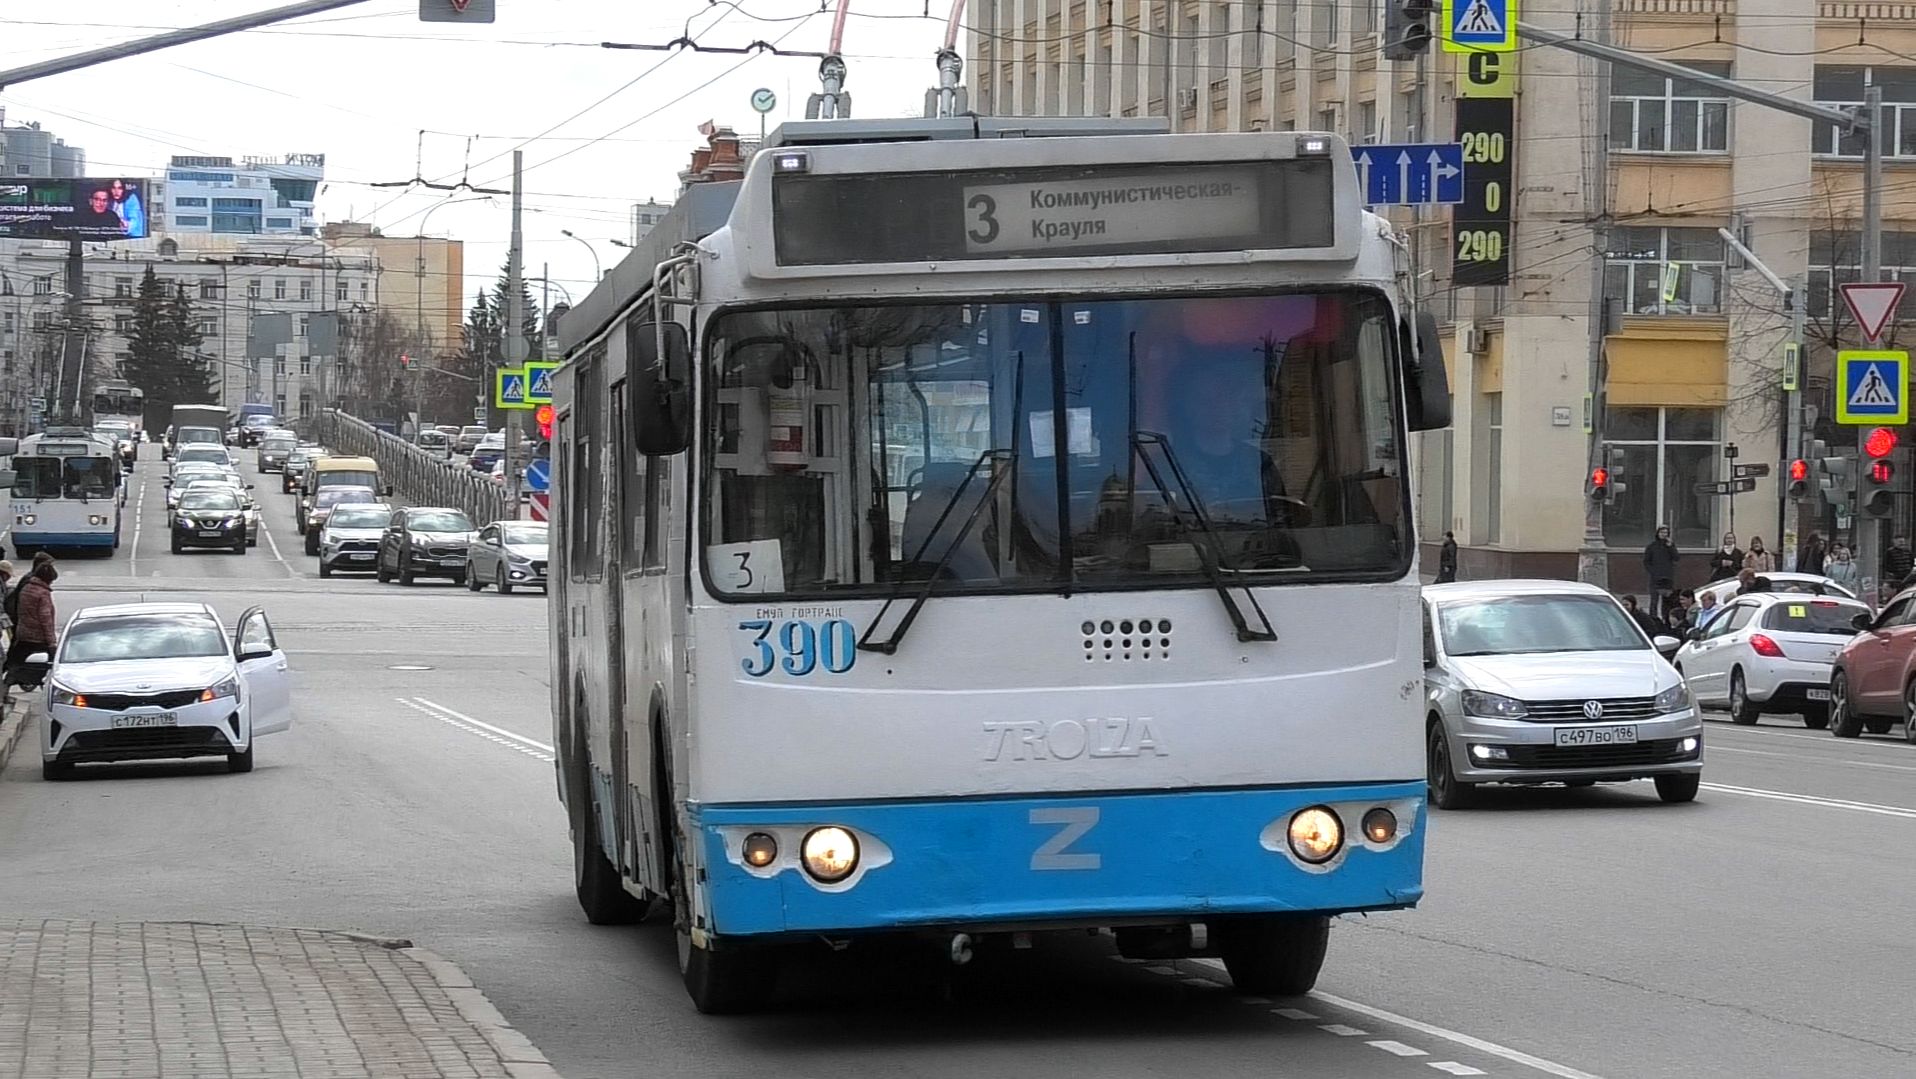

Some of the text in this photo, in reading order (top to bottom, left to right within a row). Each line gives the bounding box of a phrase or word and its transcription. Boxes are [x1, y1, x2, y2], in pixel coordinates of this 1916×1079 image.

[1462, 132, 1504, 163] 290
[1030, 184, 1241, 210] Коммунистическая-
[1485, 182, 1500, 212] 0
[967, 194, 1000, 244] 3
[1032, 219, 1106, 242] Крауля
[1458, 231, 1501, 261] 290
[14, 505, 32, 513] 151
[733, 552, 752, 588] 3
[738, 620, 856, 677] 390
[1560, 728, 1633, 744] С497ВО 196
[1029, 806, 1101, 870] Z
